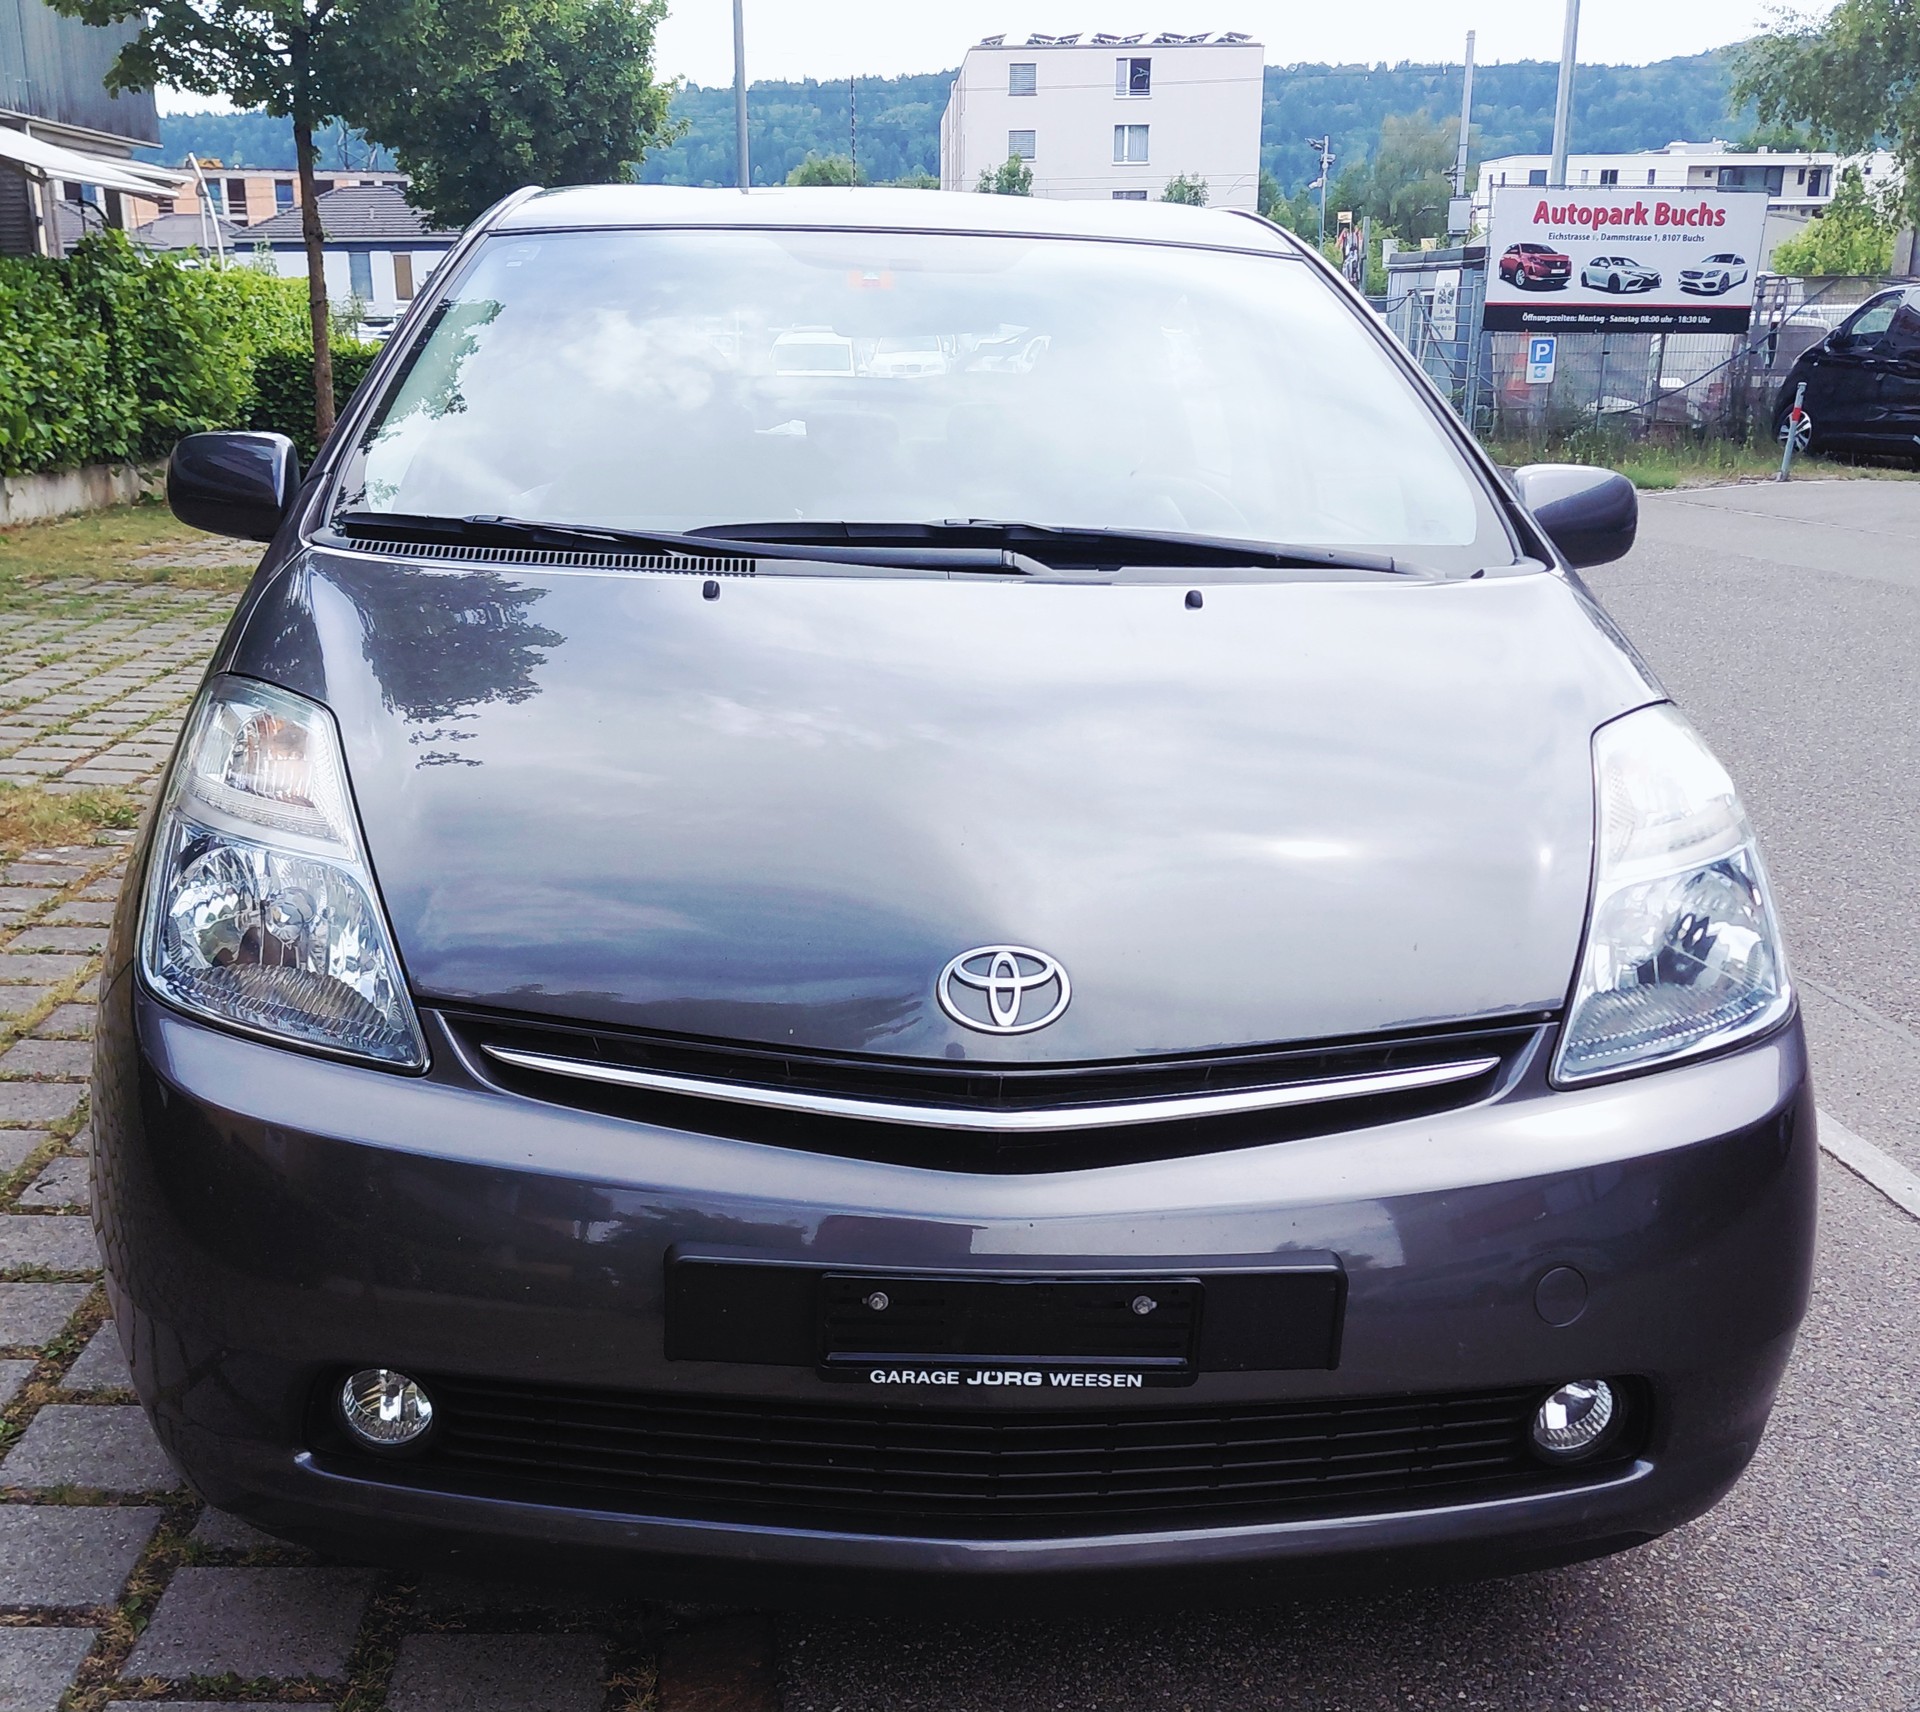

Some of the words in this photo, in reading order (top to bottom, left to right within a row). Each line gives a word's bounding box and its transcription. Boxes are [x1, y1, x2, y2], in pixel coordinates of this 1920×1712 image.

[1533, 200, 1649, 230] Autopark
[1654, 202, 1726, 226] Buchs
[1548, 232, 1590, 240] Eichstrasse
[1600, 233, 1652, 241] Dammstrasse
[1682, 234, 1705, 242] Buchs
[1522, 312, 1577, 323] Öffnungszeiten:
[1578, 314, 1605, 324] Montag
[1609, 315, 1640, 324] Samstag
[1640, 315, 1660, 323] 08:00
[1678, 315, 1697, 323] 18:30
[1698, 316, 1711, 324] Uhr
[1535, 343, 1550, 362] P
[870, 1370, 959, 1385] GARAGE
[1049, 1373, 1142, 1388] WEESEN
